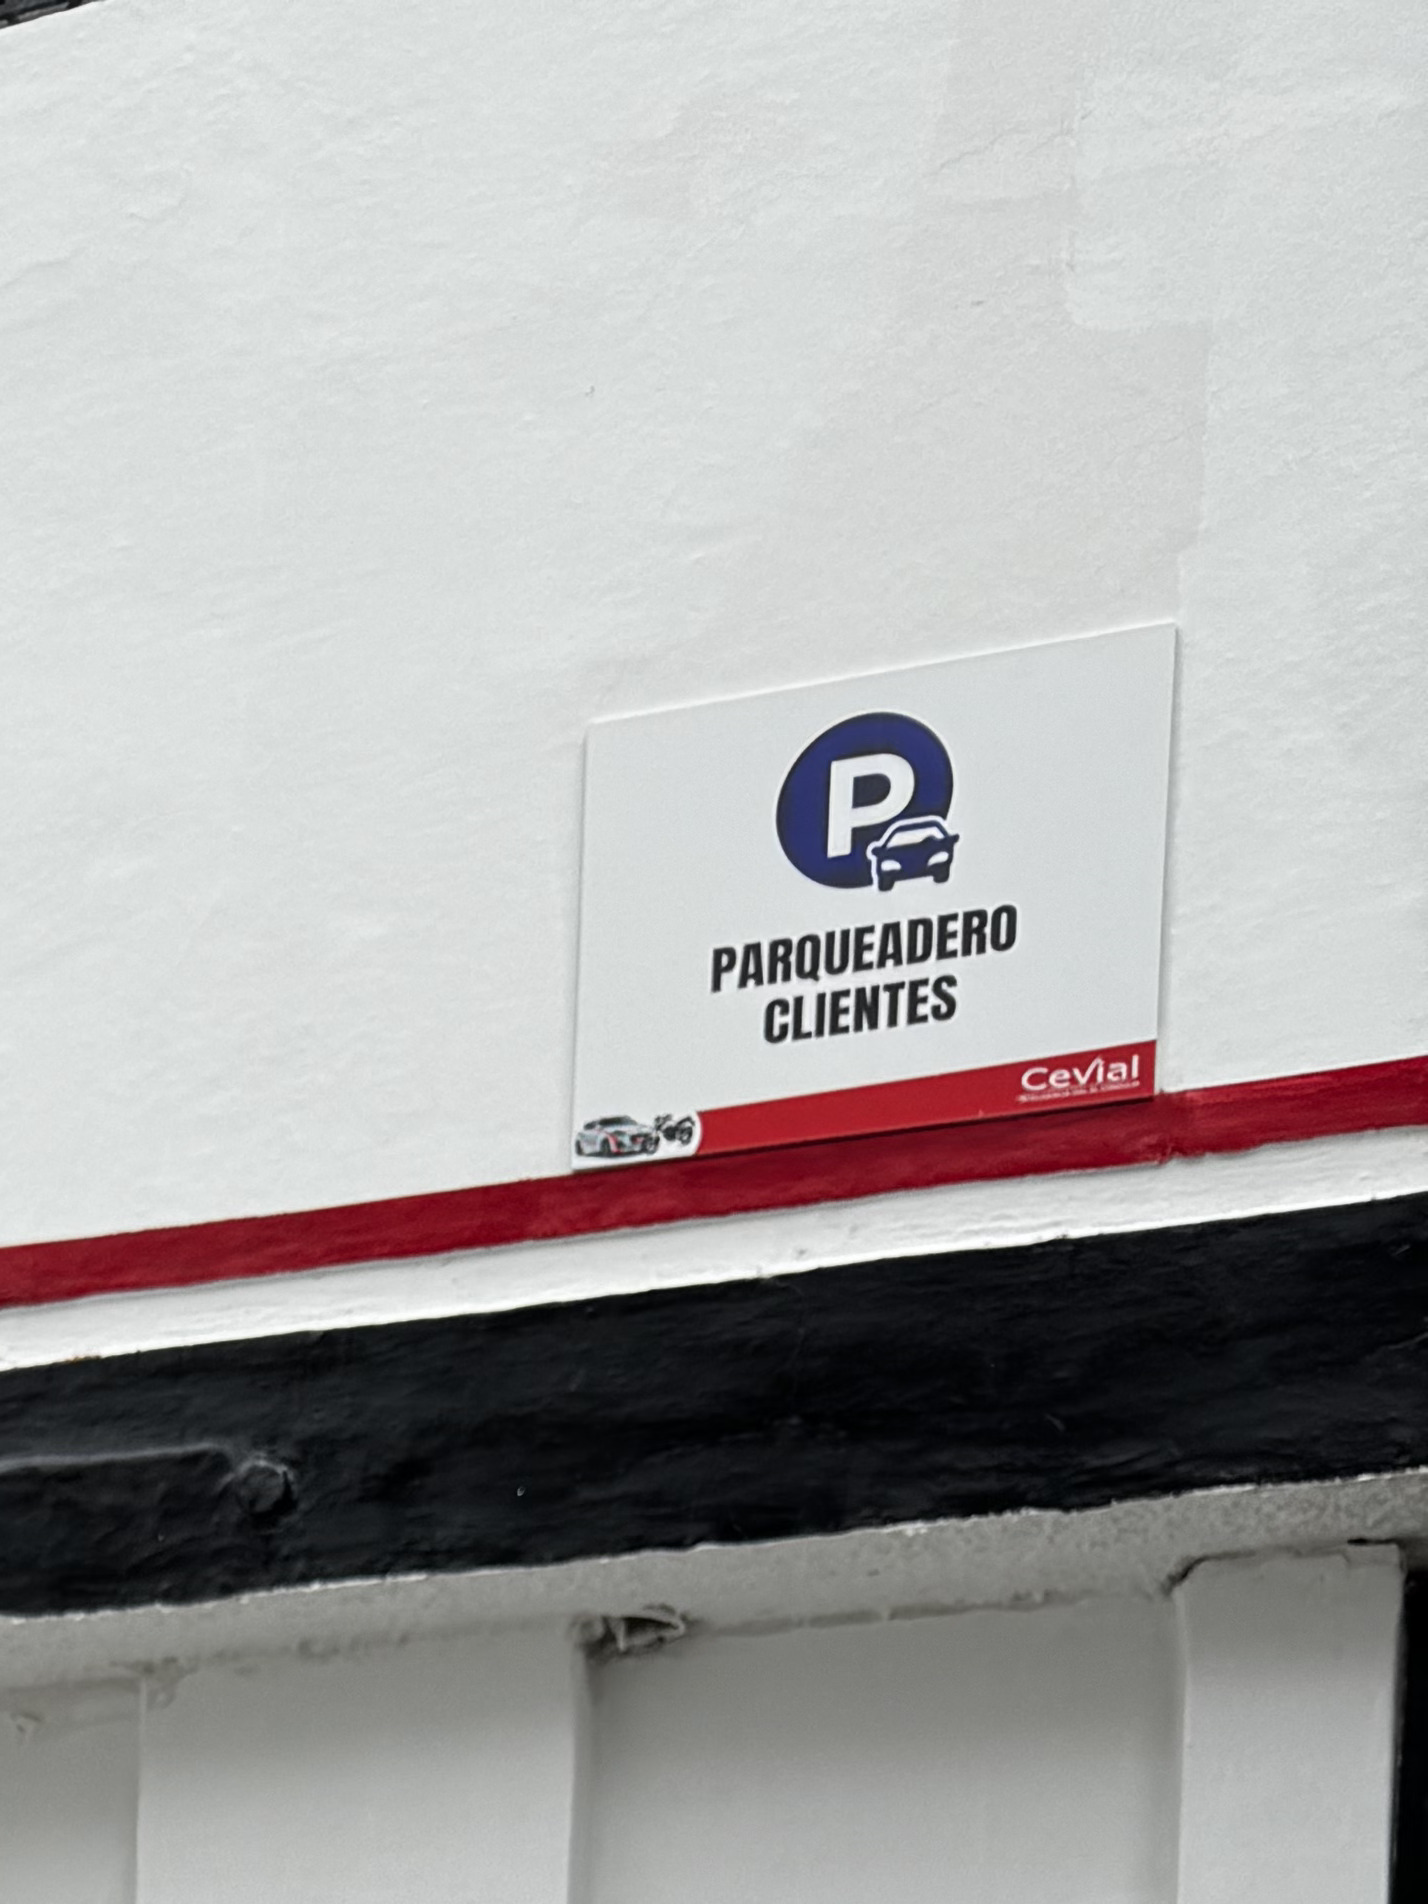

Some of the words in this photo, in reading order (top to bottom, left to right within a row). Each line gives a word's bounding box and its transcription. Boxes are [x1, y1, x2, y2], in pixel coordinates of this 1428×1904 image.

[827, 753, 915, 858] P
[710, 904, 1018, 993] PARQUEADERO
[763, 975, 958, 1044] CLIENTES
[1020, 1054, 1140, 1091] Cevial
